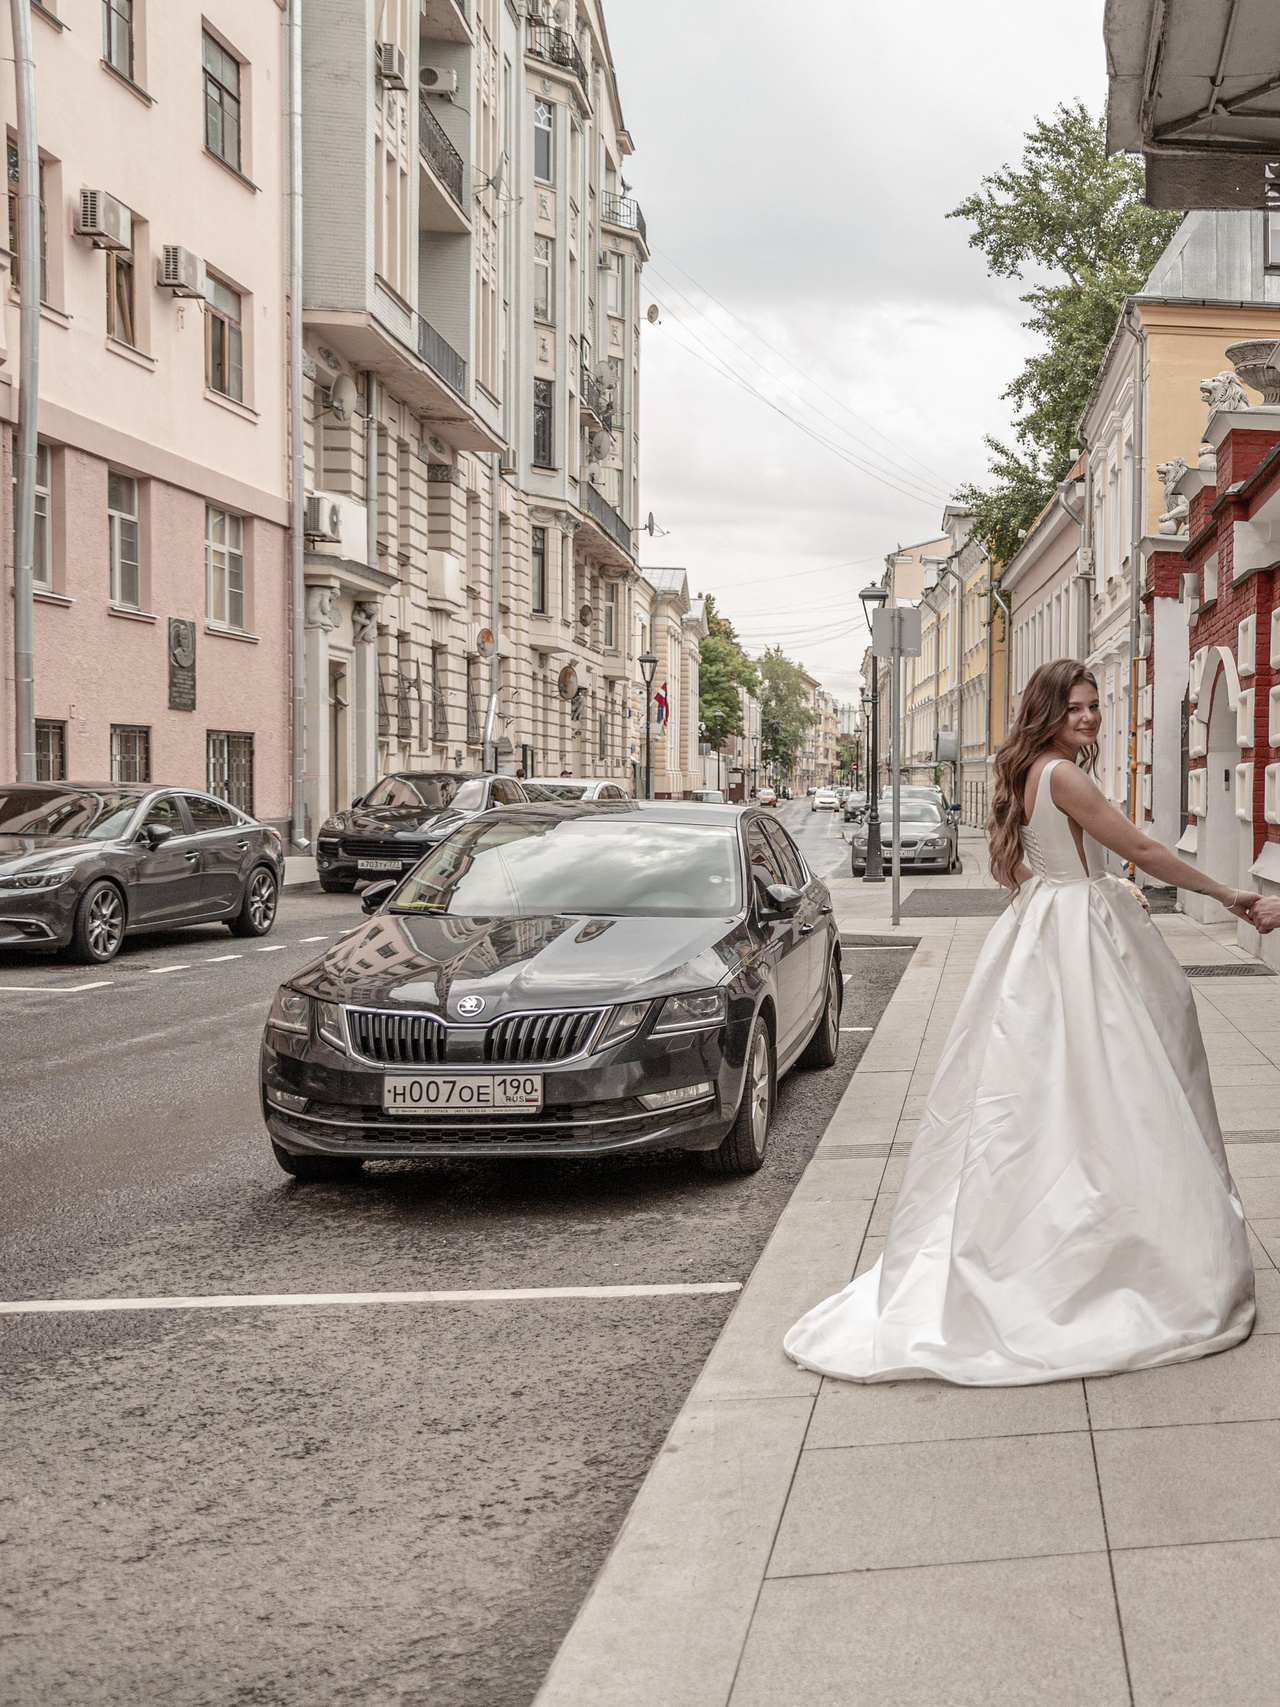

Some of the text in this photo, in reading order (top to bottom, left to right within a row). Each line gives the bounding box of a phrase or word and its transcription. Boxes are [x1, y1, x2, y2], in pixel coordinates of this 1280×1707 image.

[393, 1078, 535, 1103] Н007ОЕ 190
[506, 1095, 524, 1103] RUS
